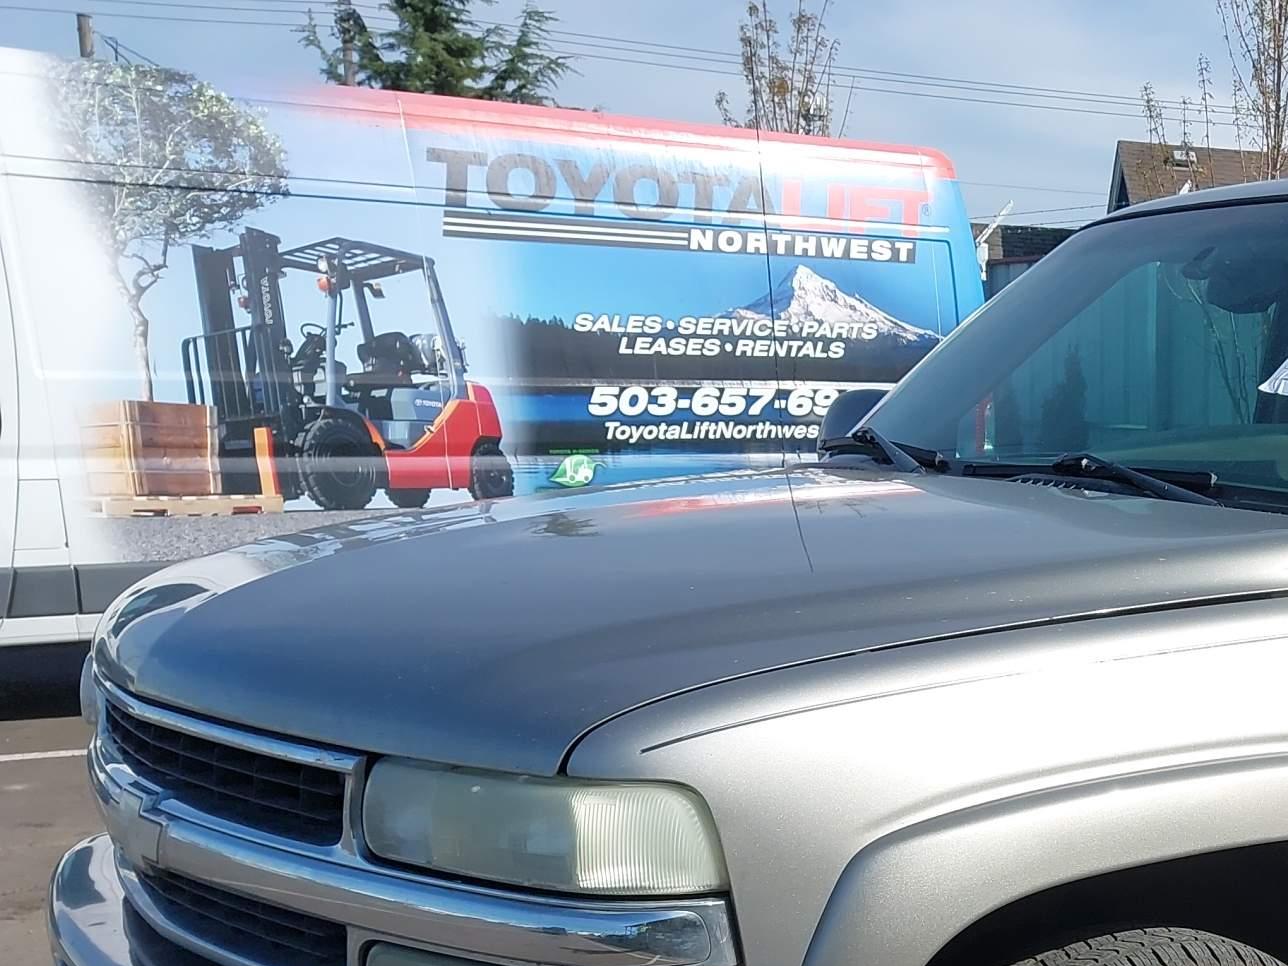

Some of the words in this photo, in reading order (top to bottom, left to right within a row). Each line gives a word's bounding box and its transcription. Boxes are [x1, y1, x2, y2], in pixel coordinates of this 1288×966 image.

[689, 227, 914, 263] NORTHWEST
[573, 313, 662, 334] SALES
[677, 316, 790, 338] SERVICE
[801, 320, 879, 340] PARTS
[618, 336, 722, 357] LEASES
[735, 339, 847, 359] RENTALS
[587, 386, 841, 417] 503-657-69
[604, 421, 821, 444] ToyotaLiftNorthwes
